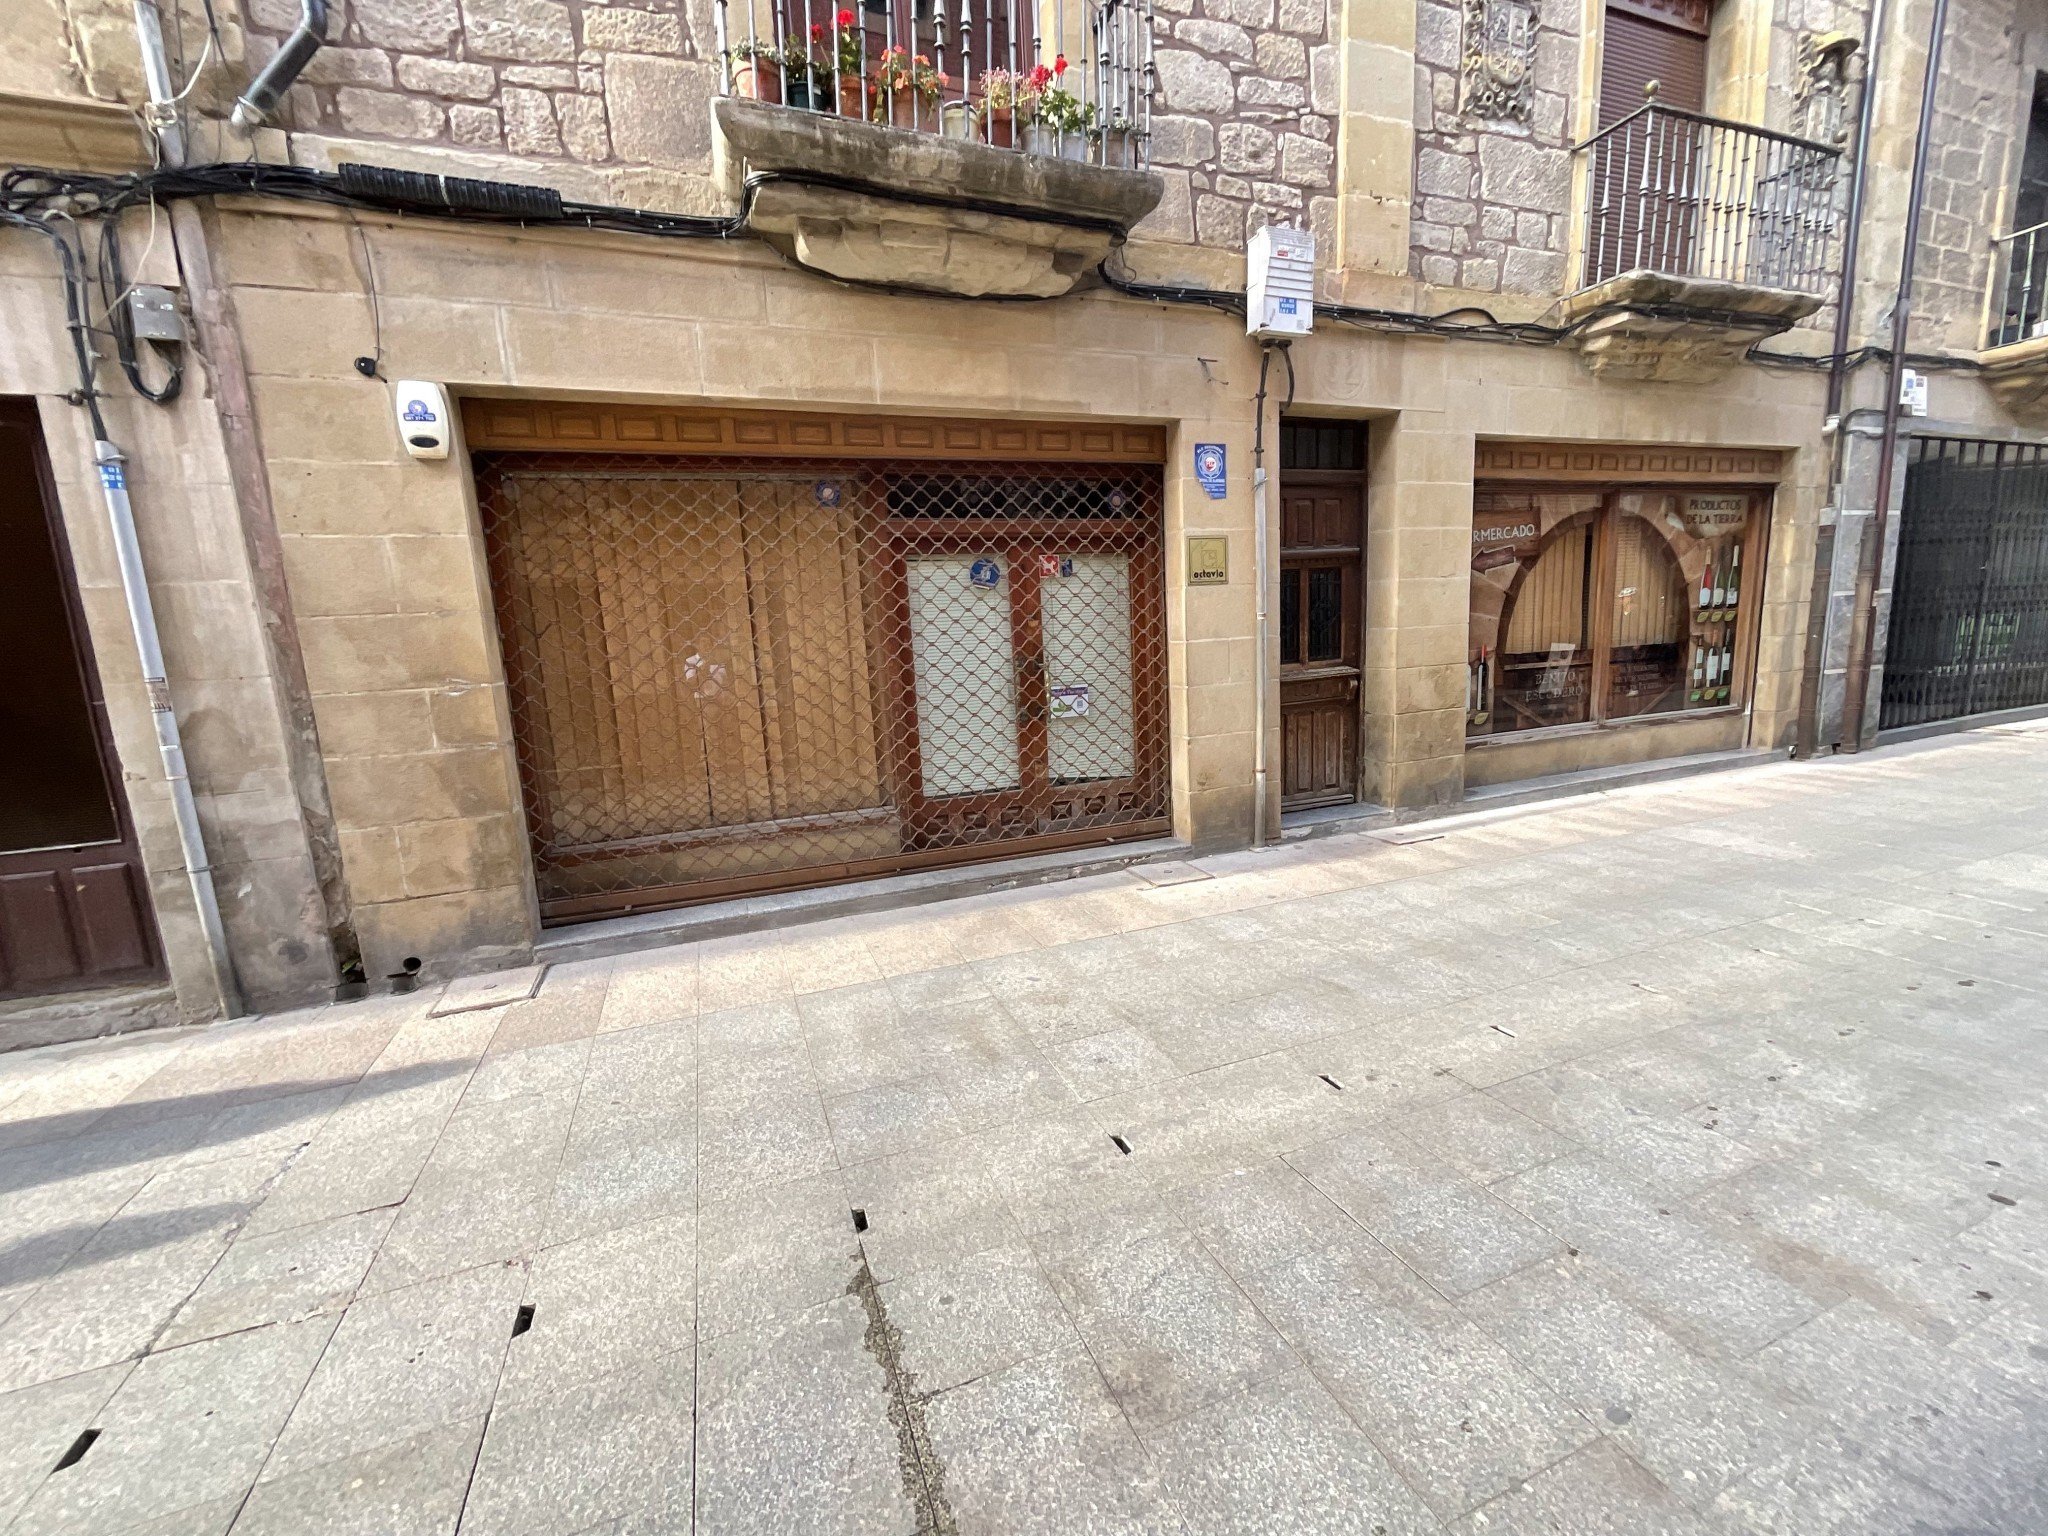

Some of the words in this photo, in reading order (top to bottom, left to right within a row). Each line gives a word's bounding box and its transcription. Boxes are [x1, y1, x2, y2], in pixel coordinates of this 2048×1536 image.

[1689, 499, 1742, 511] PRODUCTOS
[1686, 514, 1698, 525] DE
[1699, 514, 1711, 525] LA
[1713, 513, 1743, 524] TIERRA
[1473, 523, 1535, 543] RMERCADO
[1193, 569, 1224, 579] octavio
[1535, 671, 1576, 685] BENITO
[1525, 685, 1583, 702] ESCUDERO
